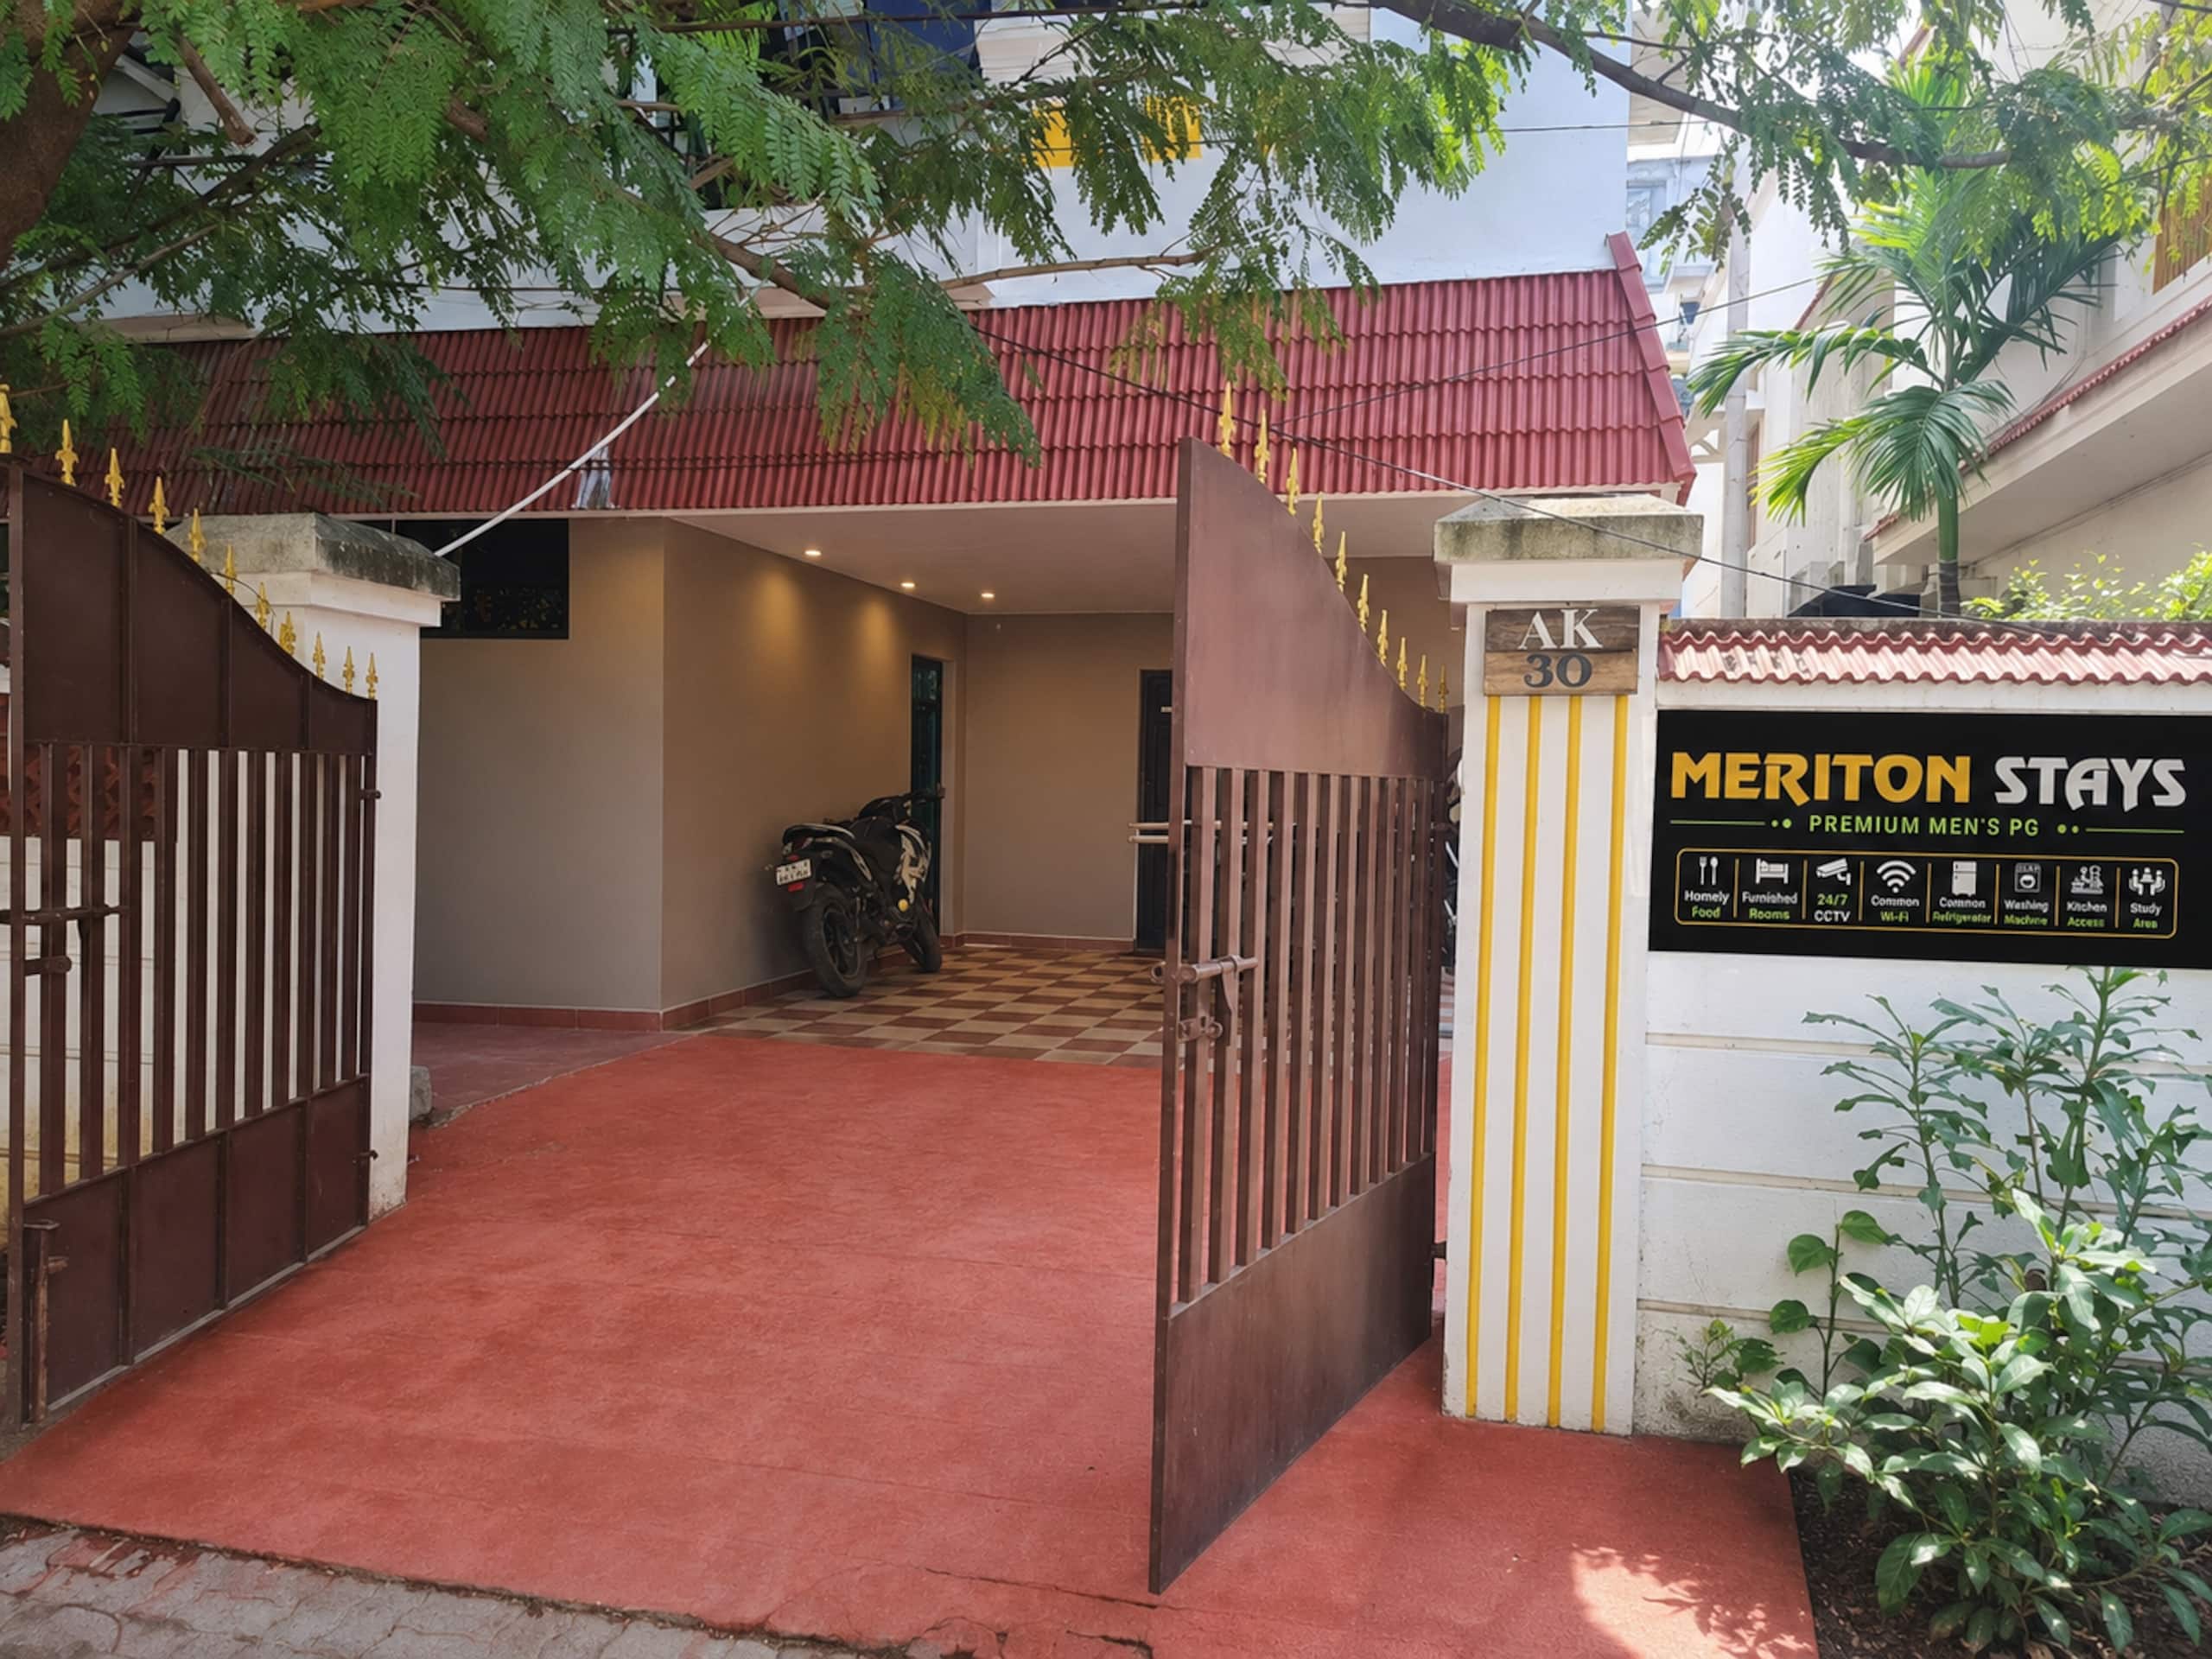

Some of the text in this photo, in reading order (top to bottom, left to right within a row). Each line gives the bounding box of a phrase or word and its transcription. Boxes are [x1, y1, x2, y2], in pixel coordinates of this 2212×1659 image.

[1517, 608, 1603, 650] AK
[1523, 653, 1592, 688] 30
[1671, 751, 2188, 811] MERITON STAYS
[1809, 814, 2039, 836] PREMIUM MEN'S PG
[1684, 890, 1729, 905] Homely
[1741, 891, 1798, 904] Furnished
[1816, 893, 1848, 906] 24/7
[1870, 894, 1920, 906] Common
[1939, 896, 1986, 908] Common
[1691, 906, 1721, 918] Food
[2003, 899, 2050, 912] Washing
[2066, 901, 2107, 912] Kitchen
[2130, 902, 2162, 916] Study
[1748, 907, 1790, 919] Rooms
[1814, 910, 1851, 922] CCTV
[1932, 911, 1992, 925] Refrigerator
[2003, 914, 2048, 926] Machine
[2067, 917, 2106, 927] Access
[2133, 918, 2158, 928] Area
